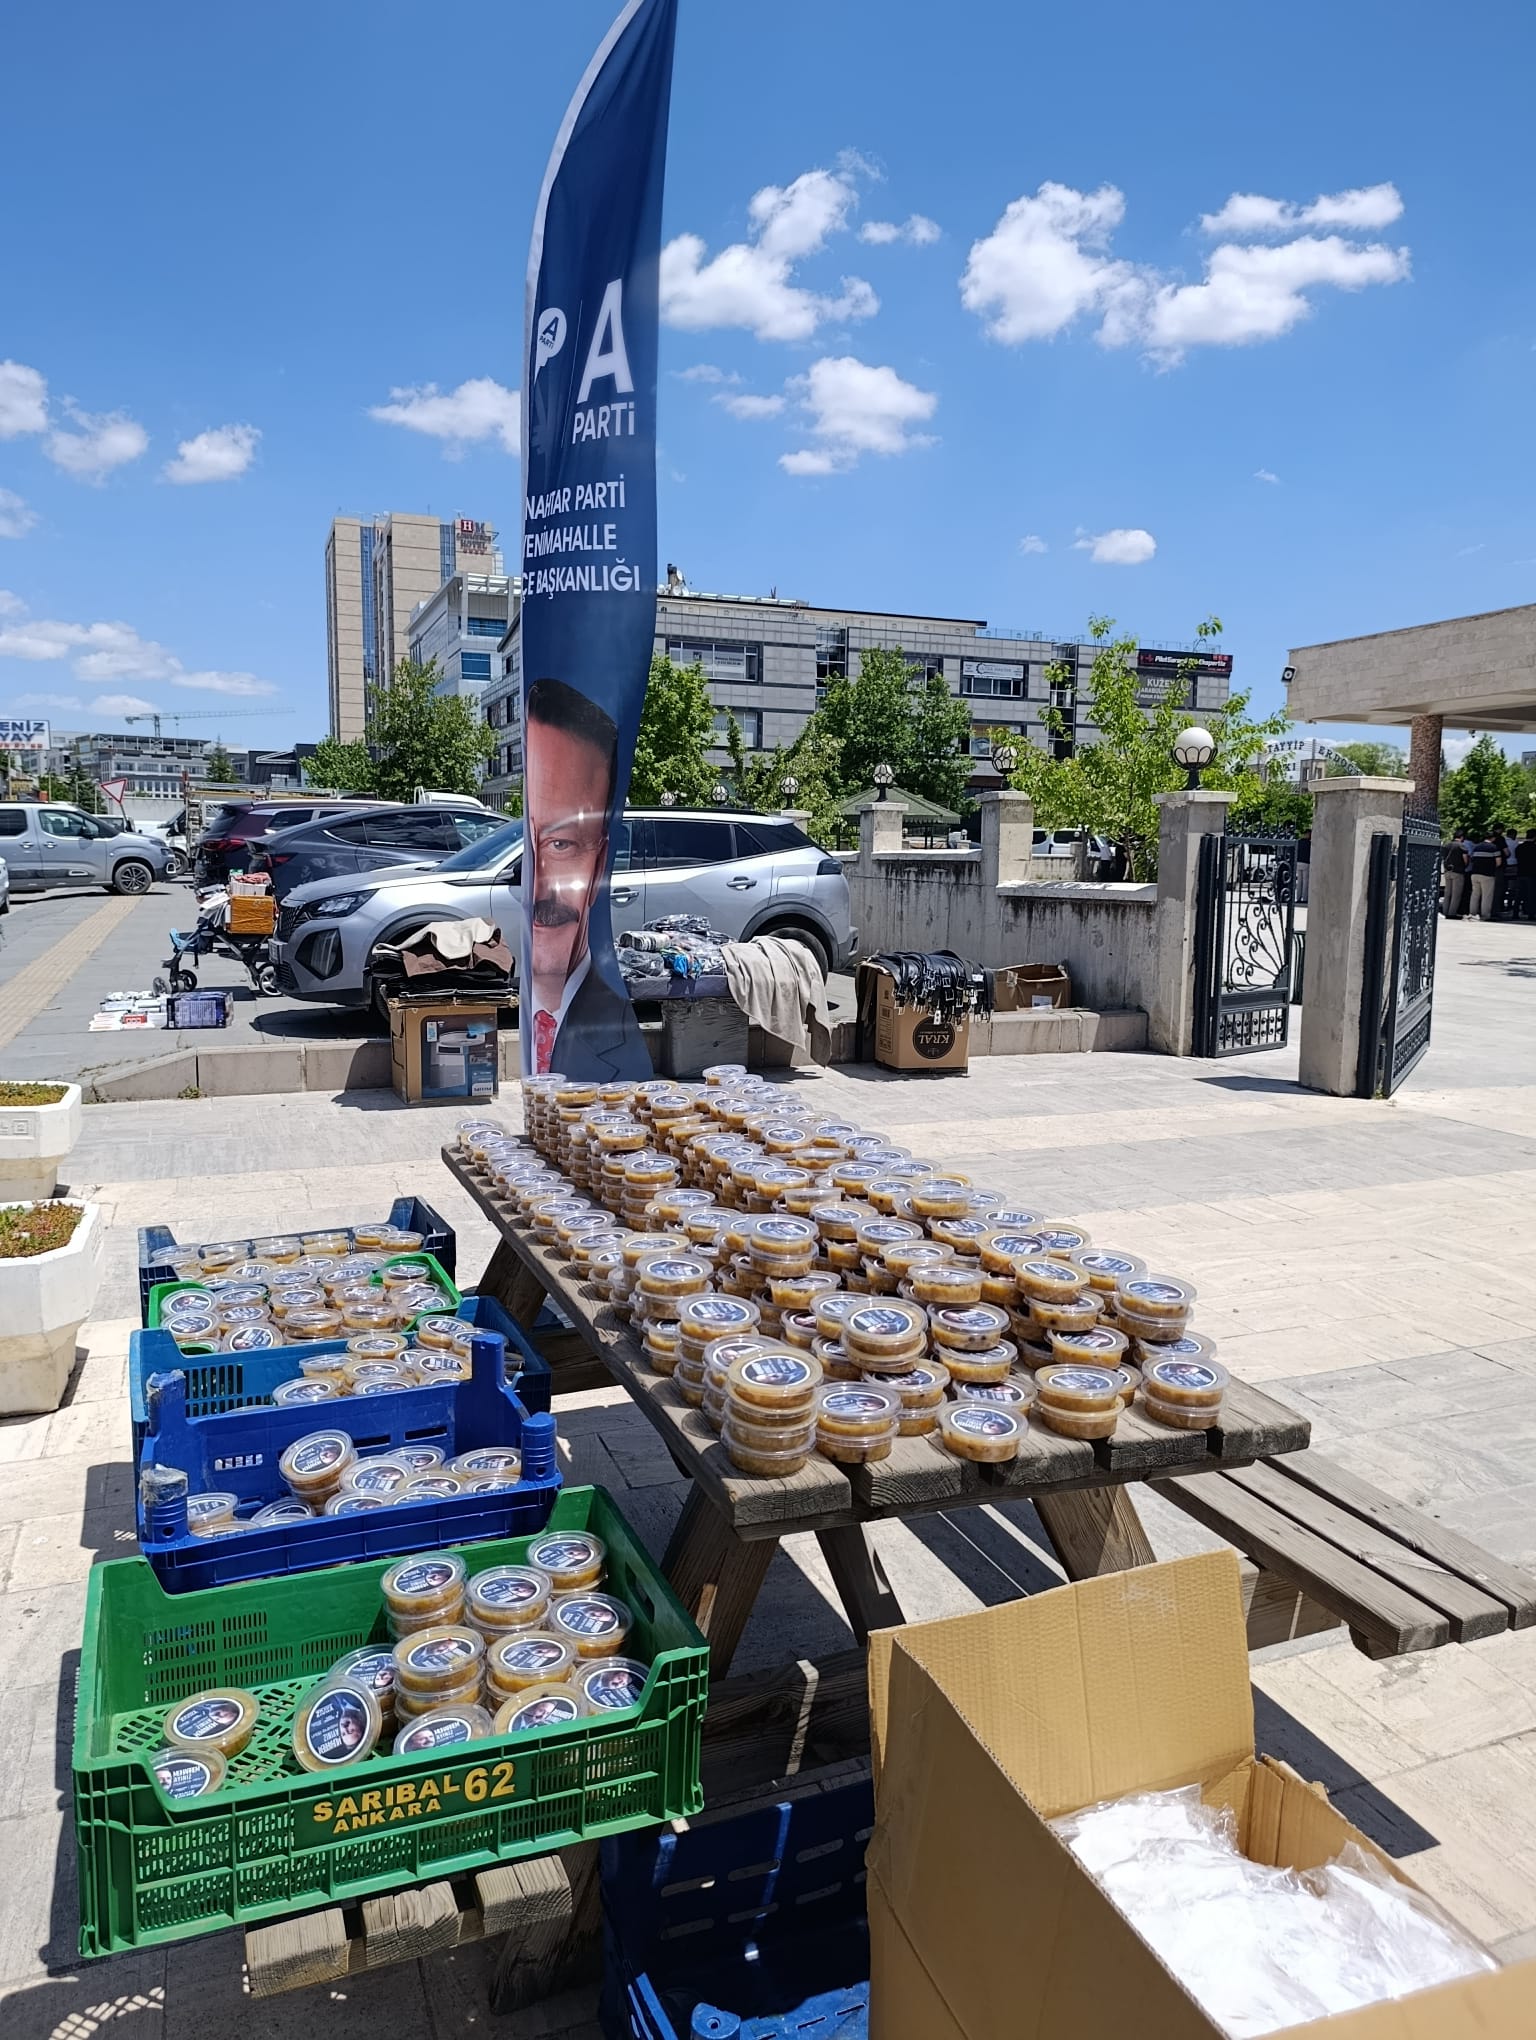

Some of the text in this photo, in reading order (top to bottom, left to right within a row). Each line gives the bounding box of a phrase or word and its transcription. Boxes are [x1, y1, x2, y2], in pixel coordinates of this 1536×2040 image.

[577, 278, 634, 404] A
[572, 401, 635, 444] PARTİ
[575, 473, 625, 511] PARTİ
[535, 558, 641, 600] BAŞKANLIĞI
[918, 1034, 950, 1044] KRAL
[313, 1761, 516, 1822] SARIBAL 62
[333, 1798, 442, 1834] ANKARA
